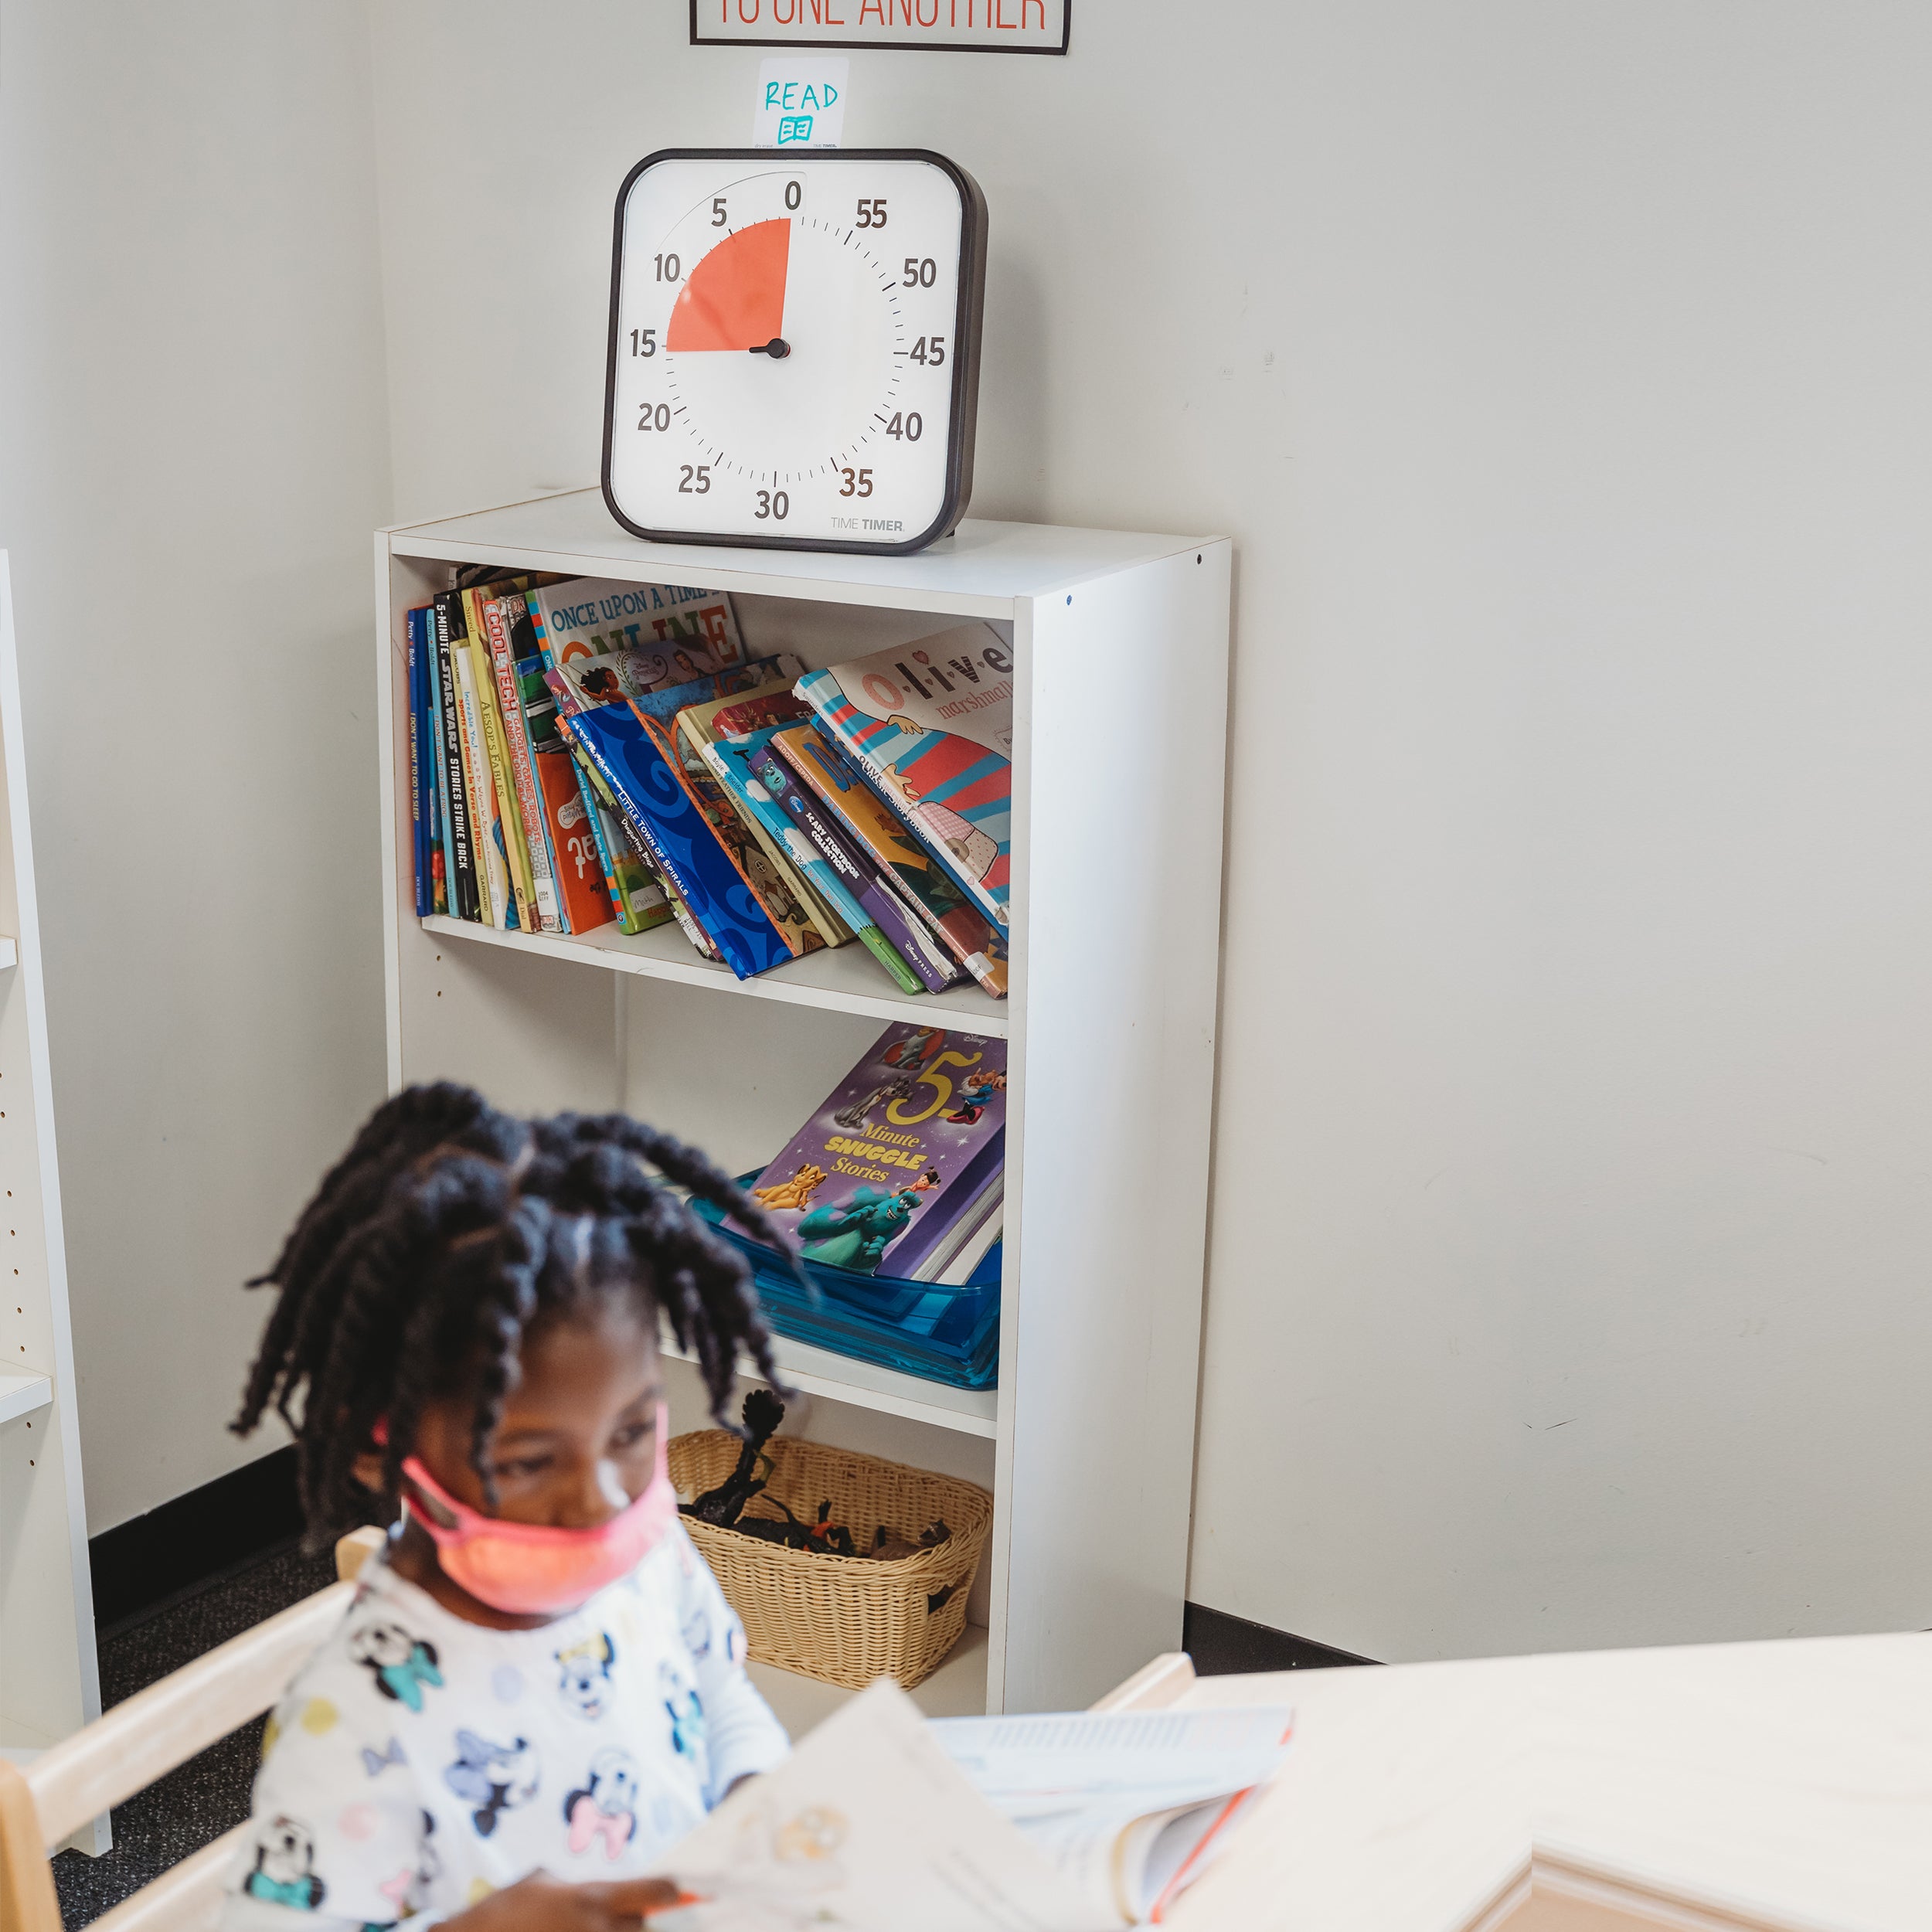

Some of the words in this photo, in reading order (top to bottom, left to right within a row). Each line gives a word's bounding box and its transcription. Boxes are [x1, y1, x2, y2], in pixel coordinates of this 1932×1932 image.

[765, 81, 838, 111] READ
[784, 181, 802, 210] 0
[711, 198, 727, 227] 5
[855, 199, 887, 229] 55
[654, 253, 680, 282] 10
[902, 257, 937, 288] 50
[630, 328, 657, 358] 15
[910, 335, 945, 366] 45
[638, 403, 671, 432] 20
[886, 412, 923, 441] 40
[678, 464, 711, 494] 25
[838, 468, 873, 498] 35
[753, 490, 789, 520] 30
[831, 517, 859, 529] TIME
[464, 605, 475, 632] Sneed
[511, 597, 526, 614] DK
[551, 602, 600, 632] ONCE
[599, 590, 648, 621] UPON
[651, 587, 665, 610] A
[436, 604, 449, 655] 5-MINUTE
[488, 612, 508, 661] COOL
[498, 665, 518, 712] TECH
[440, 658, 454, 706] STAR
[935, 680, 1013, 719] marshmall
[445, 706, 457, 753] WARS
[464, 692, 474, 727] Incredible
[469, 730, 478, 748] You!
[505, 718, 515, 739] AND
[510, 743, 519, 760] THE
[512, 718, 528, 764] GADGETS,
[411, 765, 417, 774] TO
[438, 769, 444, 779] TO
[464, 746, 472, 773] Games
[712, 757, 725, 771] Boyle
[777, 744, 814, 786] ADOFF/CEPEDA
[859, 754, 883, 783] OLIVE
[412, 776, 417, 787] GO
[449, 757, 461, 800] STORIES
[490, 753, 506, 798] FABLES
[513, 763, 526, 801] DIGITAL
[413, 789, 418, 798] TO
[468, 786, 477, 809] Verse
[576, 768, 587, 788] David
[582, 789, 595, 818] Bedford
[453, 802, 464, 839] STRIKE
[519, 801, 532, 835] WORLD
[735, 800, 751, 823] FRIENDS
[456, 842, 468, 869] BACK
[472, 830, 483, 860] Rhyme
[617, 791, 640, 820] LITTLE
[637, 821, 656, 845] TOWN
[654, 847, 664, 859] OF
[662, 859, 689, 895] SPIRALS
[619, 818, 645, 852] Disgusting
[641, 852, 655, 868] Bugs
[771, 827, 789, 846] Teddy
[787, 845, 797, 855] the
[794, 855, 808, 869] Dog
[804, 811, 826, 836] SCARY
[823, 836, 861, 879] STORYBOOK
[809, 830, 848, 873] COLLECTION
[821, 794, 857, 835] DARING
[855, 834, 876, 858] DOG
[888, 871, 927, 915] CAPTAIN
[924, 913, 943, 934] CAT
[917, 960, 932, 978] PRESS
[860, 1123, 920, 1148] Minute
[825, 1136, 927, 1170] SNUGGLE
[831, 1158, 889, 1182] Stories
